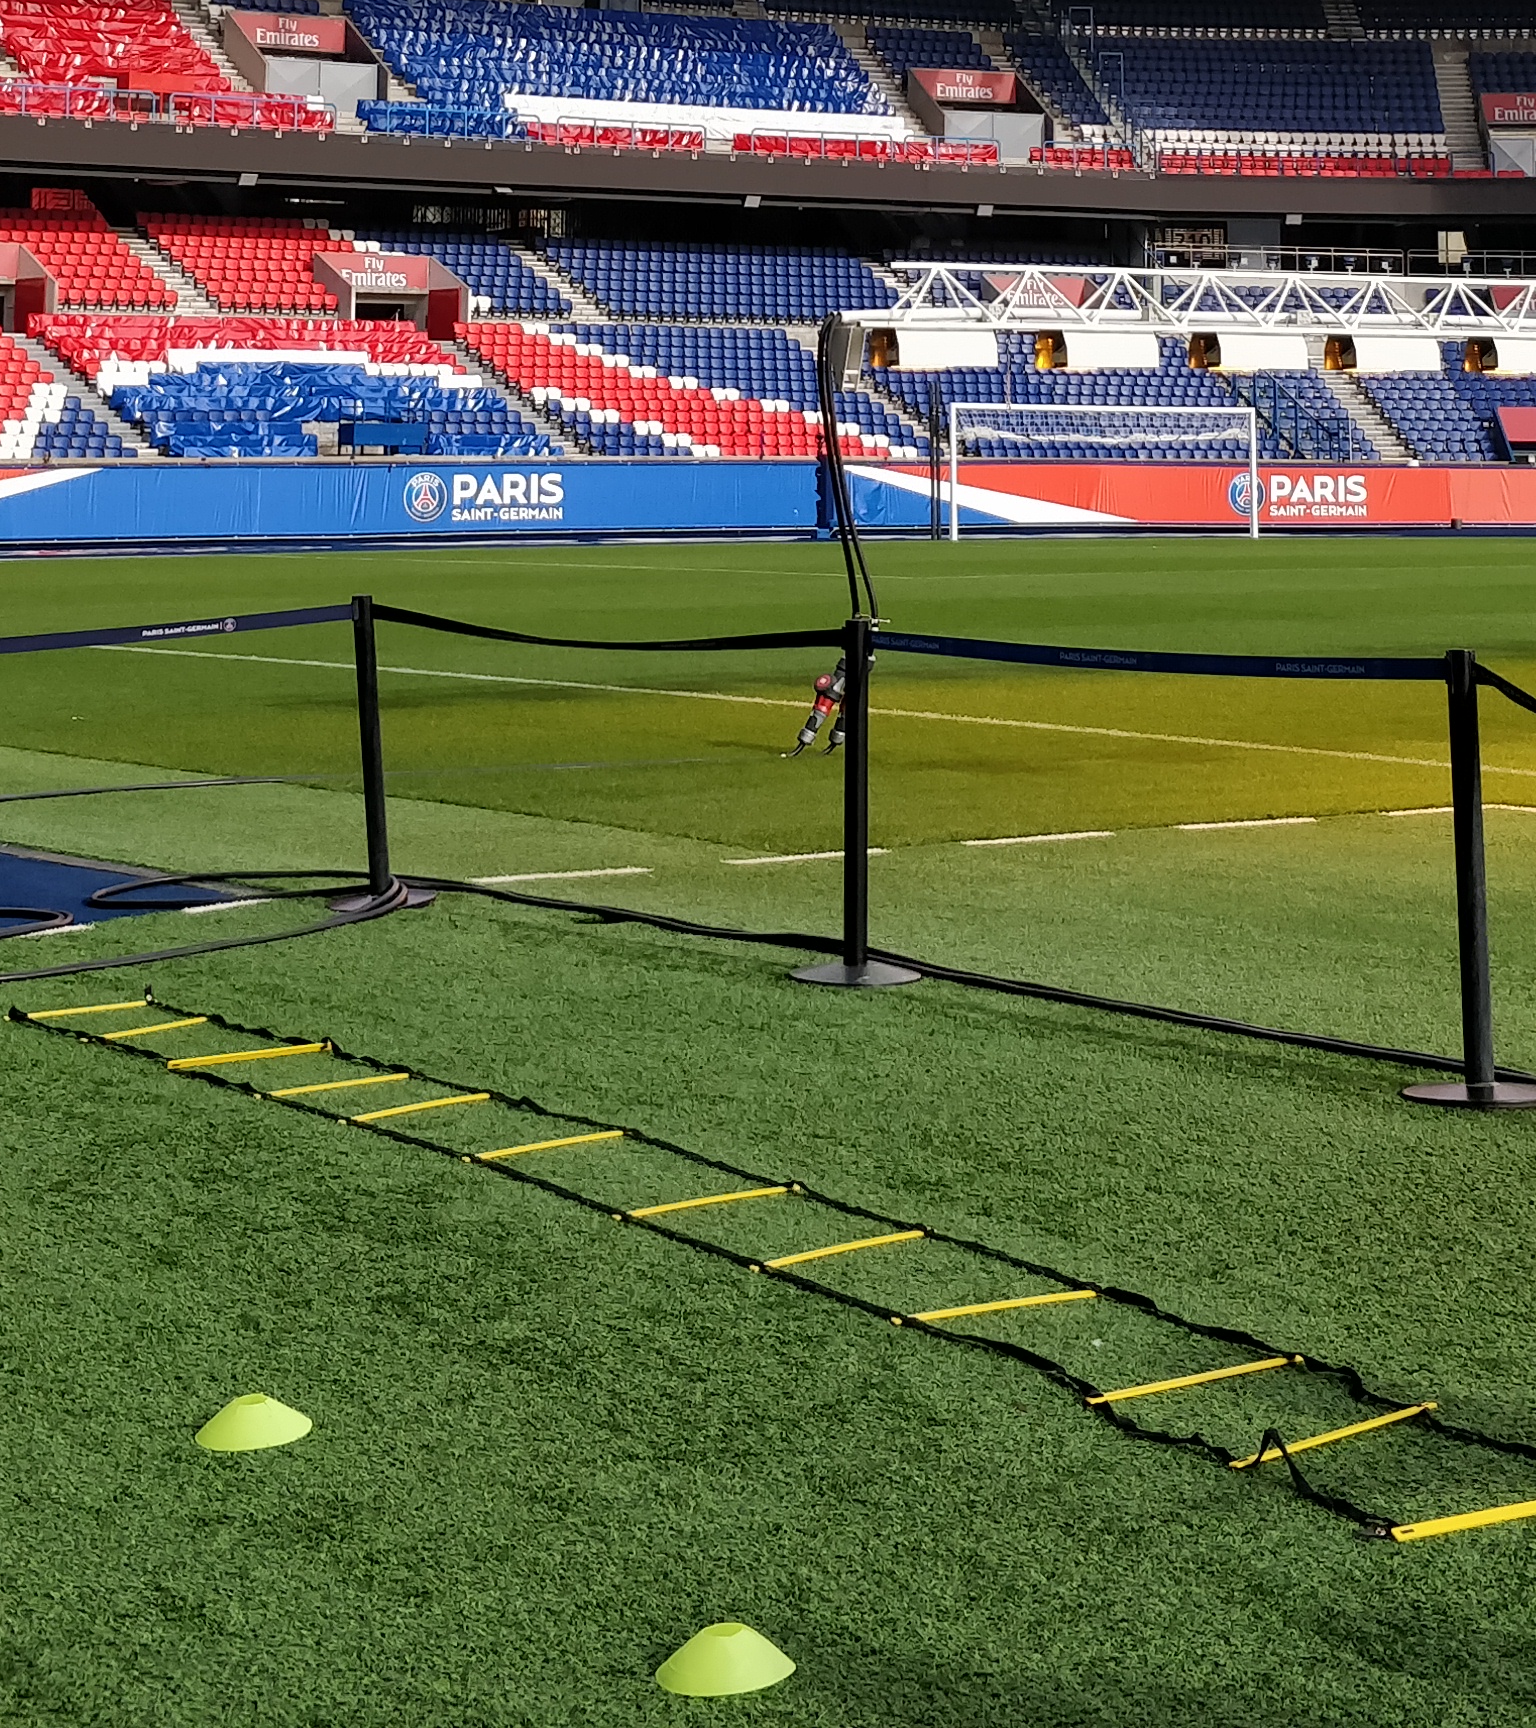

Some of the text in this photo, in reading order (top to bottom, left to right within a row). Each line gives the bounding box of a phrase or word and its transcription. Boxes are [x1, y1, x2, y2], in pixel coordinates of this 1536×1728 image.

[278, 17, 297, 31] Fly
[256, 27, 319, 47] Emirates
[955, 72, 973, 86] Fly
[936, 82, 993, 99] Emirates
[1516, 96, 1535, 108] Fly
[364, 256, 384, 271] Fly
[411, 474, 440, 488] PARIS
[452, 473, 564, 505] PARIS
[1270, 474, 1368, 503] PARIS
[451, 507, 563, 521] SAINT-GERMAIN
[1269, 504, 1367, 517] SAINT-GERMAIN
